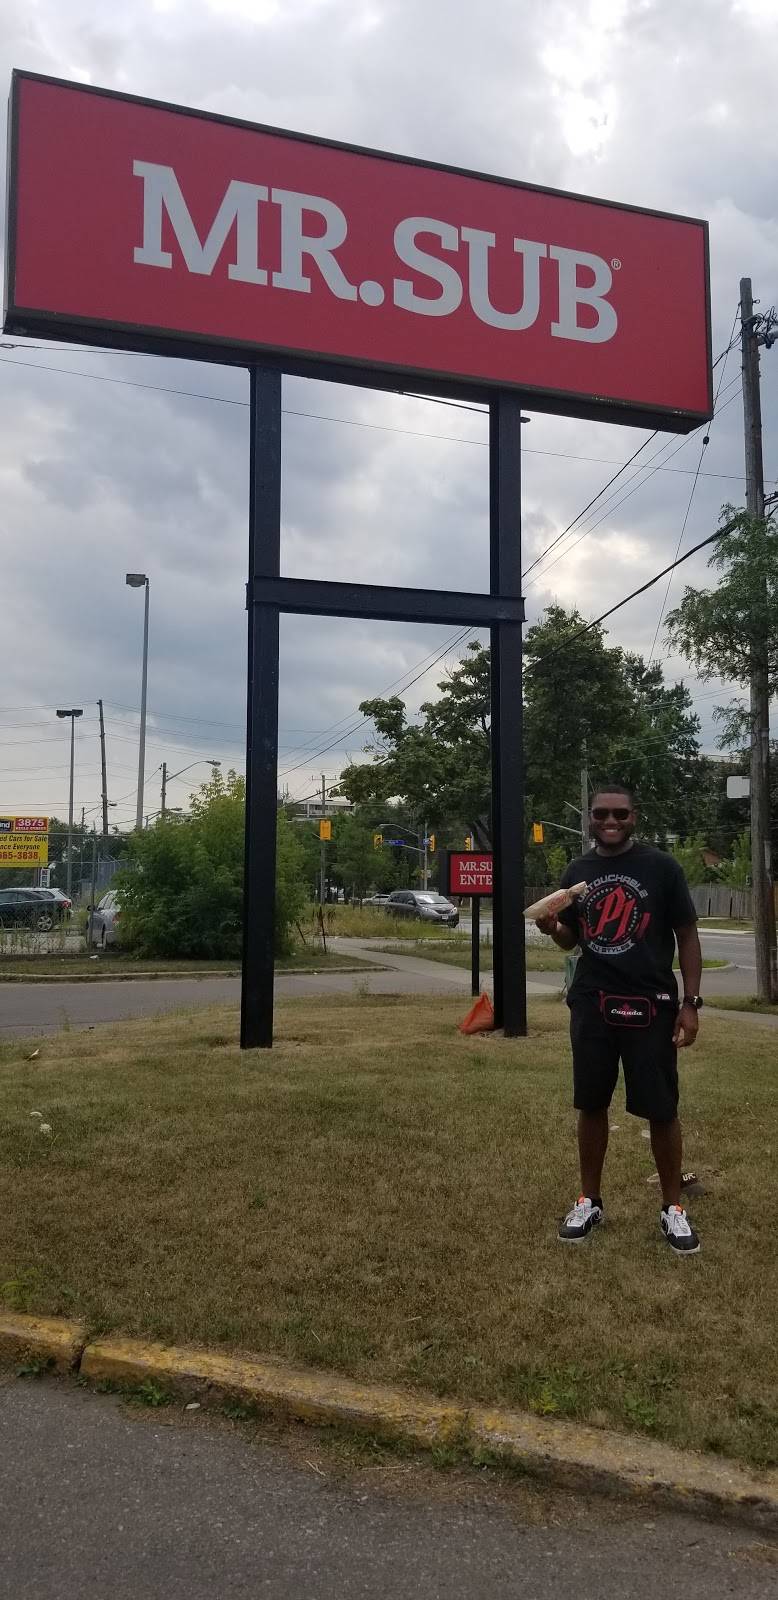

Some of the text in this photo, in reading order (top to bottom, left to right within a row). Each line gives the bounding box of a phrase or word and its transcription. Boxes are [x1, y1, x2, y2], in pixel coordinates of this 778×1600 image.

[133, 159, 617, 344] MR.SUB
[18, 818, 44, 826] 3875
[13, 843, 40, 851] Everyone
[459, 861, 493, 871] MR.SU
[460, 874, 493, 885] ENTE
[577, 874, 649, 902] UTOUCHABLE
[610, 1008, 643, 1016] Canada
[682, 1172, 696, 1181] UFC
